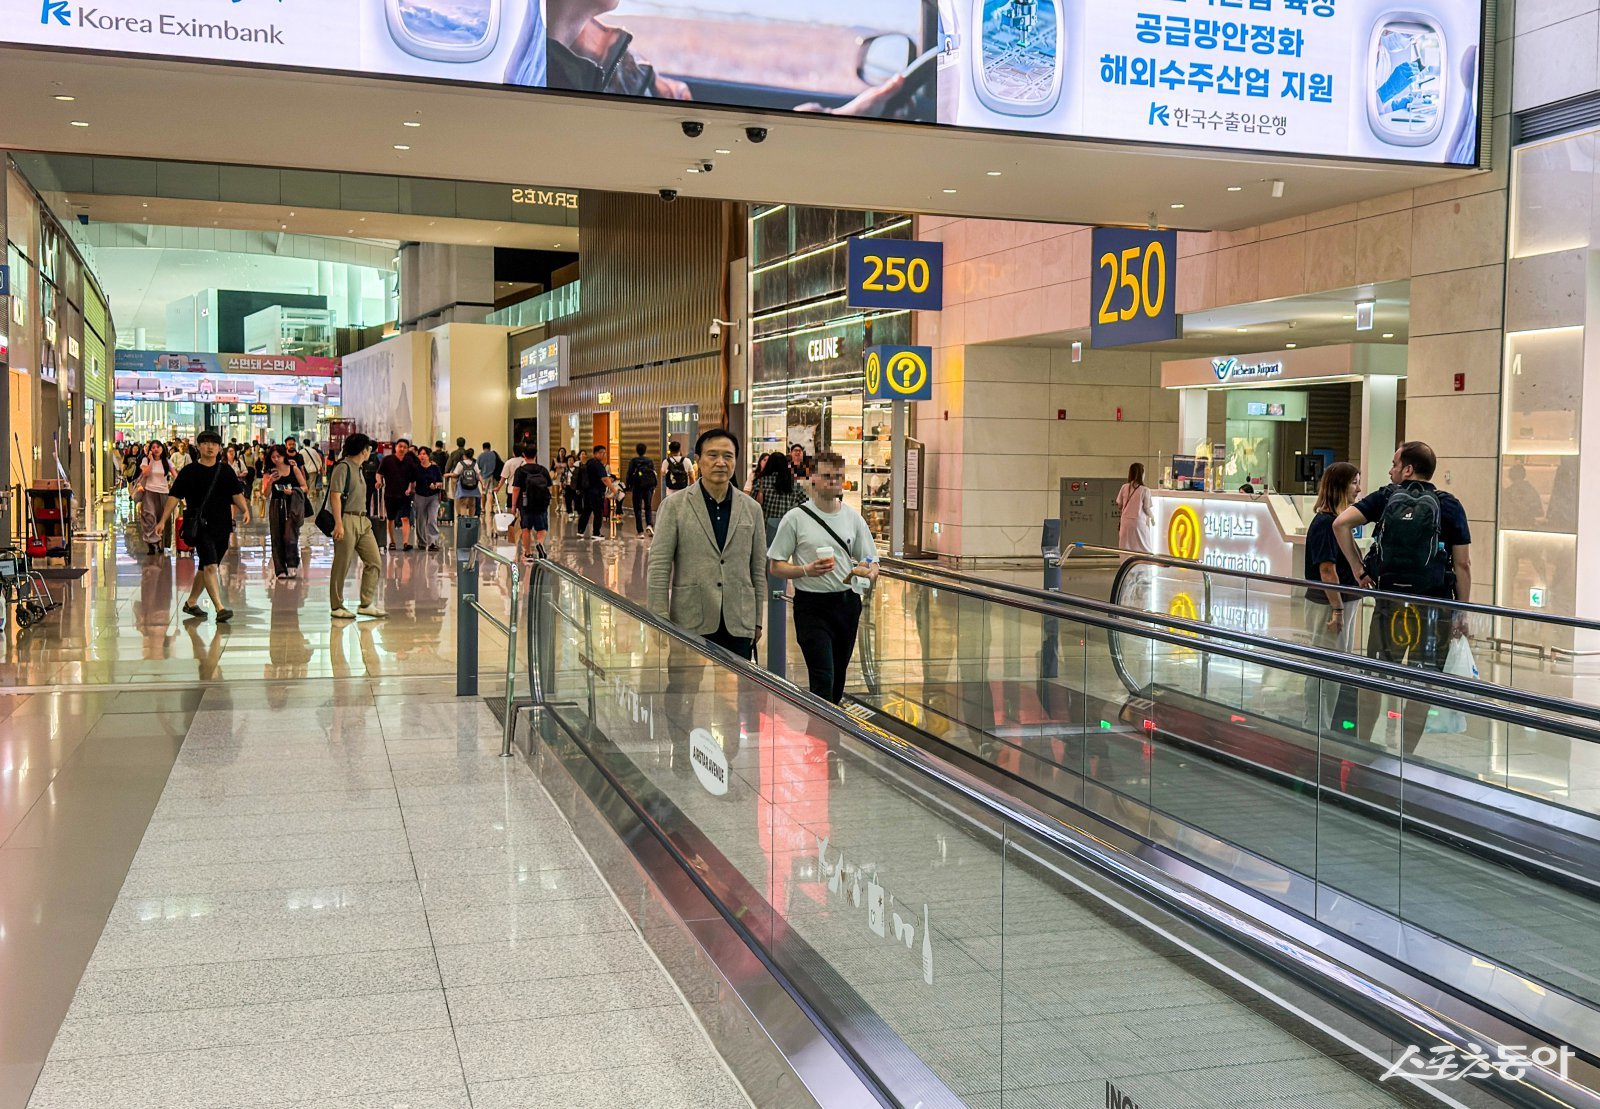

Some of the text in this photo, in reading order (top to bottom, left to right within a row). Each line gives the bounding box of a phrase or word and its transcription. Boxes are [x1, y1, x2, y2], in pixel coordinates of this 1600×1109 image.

[78, 7, 285, 45] Korea Eximbank
[1135, 12, 1304, 58] 공급망안정화
[1100, 53, 1333, 103] 해외수주산업 지원
[1173, 107, 1288, 136] 한국수출입은행
[862, 256, 930, 293] 250
[1098, 241, 1167, 324] 250
[808, 336, 839, 362] CELINE
[251, 404, 268, 414] 252
[1203, 514, 1256, 538] 안내데스크
